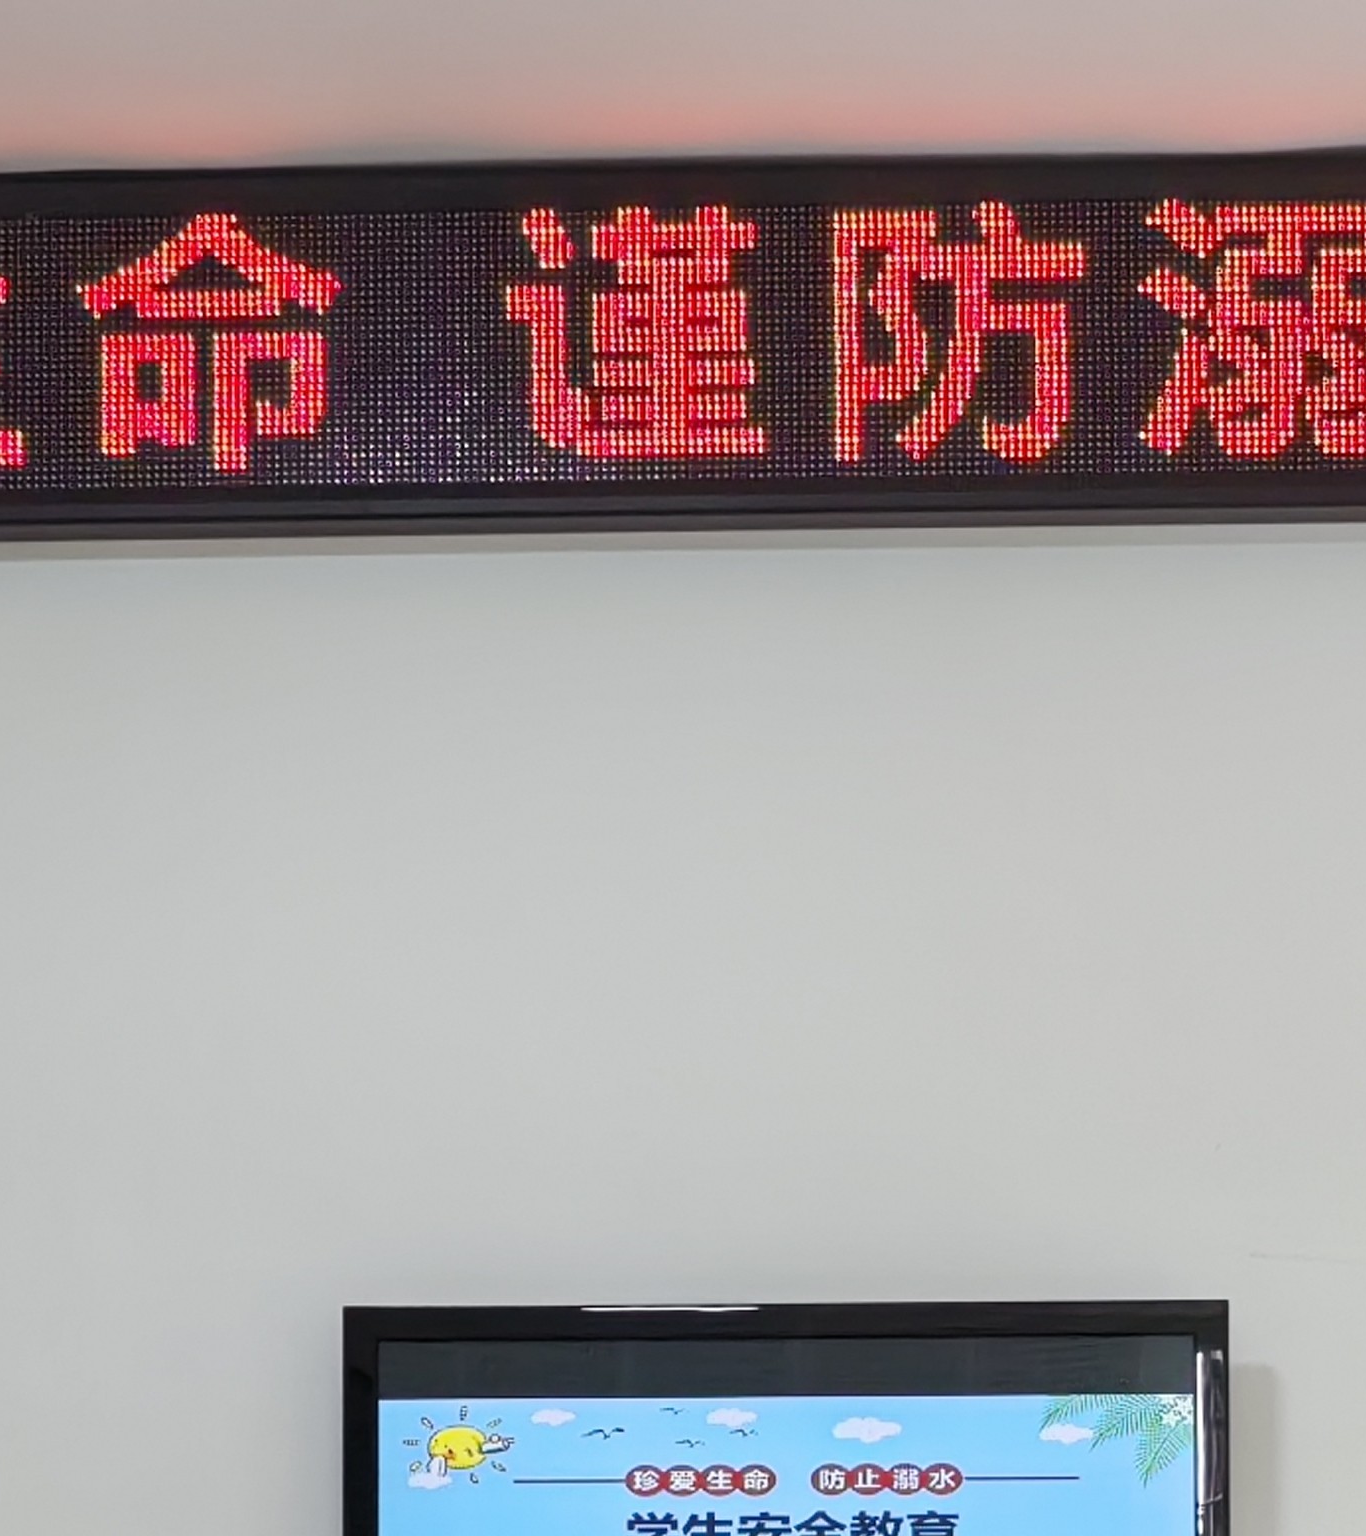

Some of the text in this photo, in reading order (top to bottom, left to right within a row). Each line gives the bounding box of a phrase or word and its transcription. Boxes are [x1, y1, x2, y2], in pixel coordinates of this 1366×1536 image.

[633, 1468, 958, 1491] 珍爱生命 防止溺水
